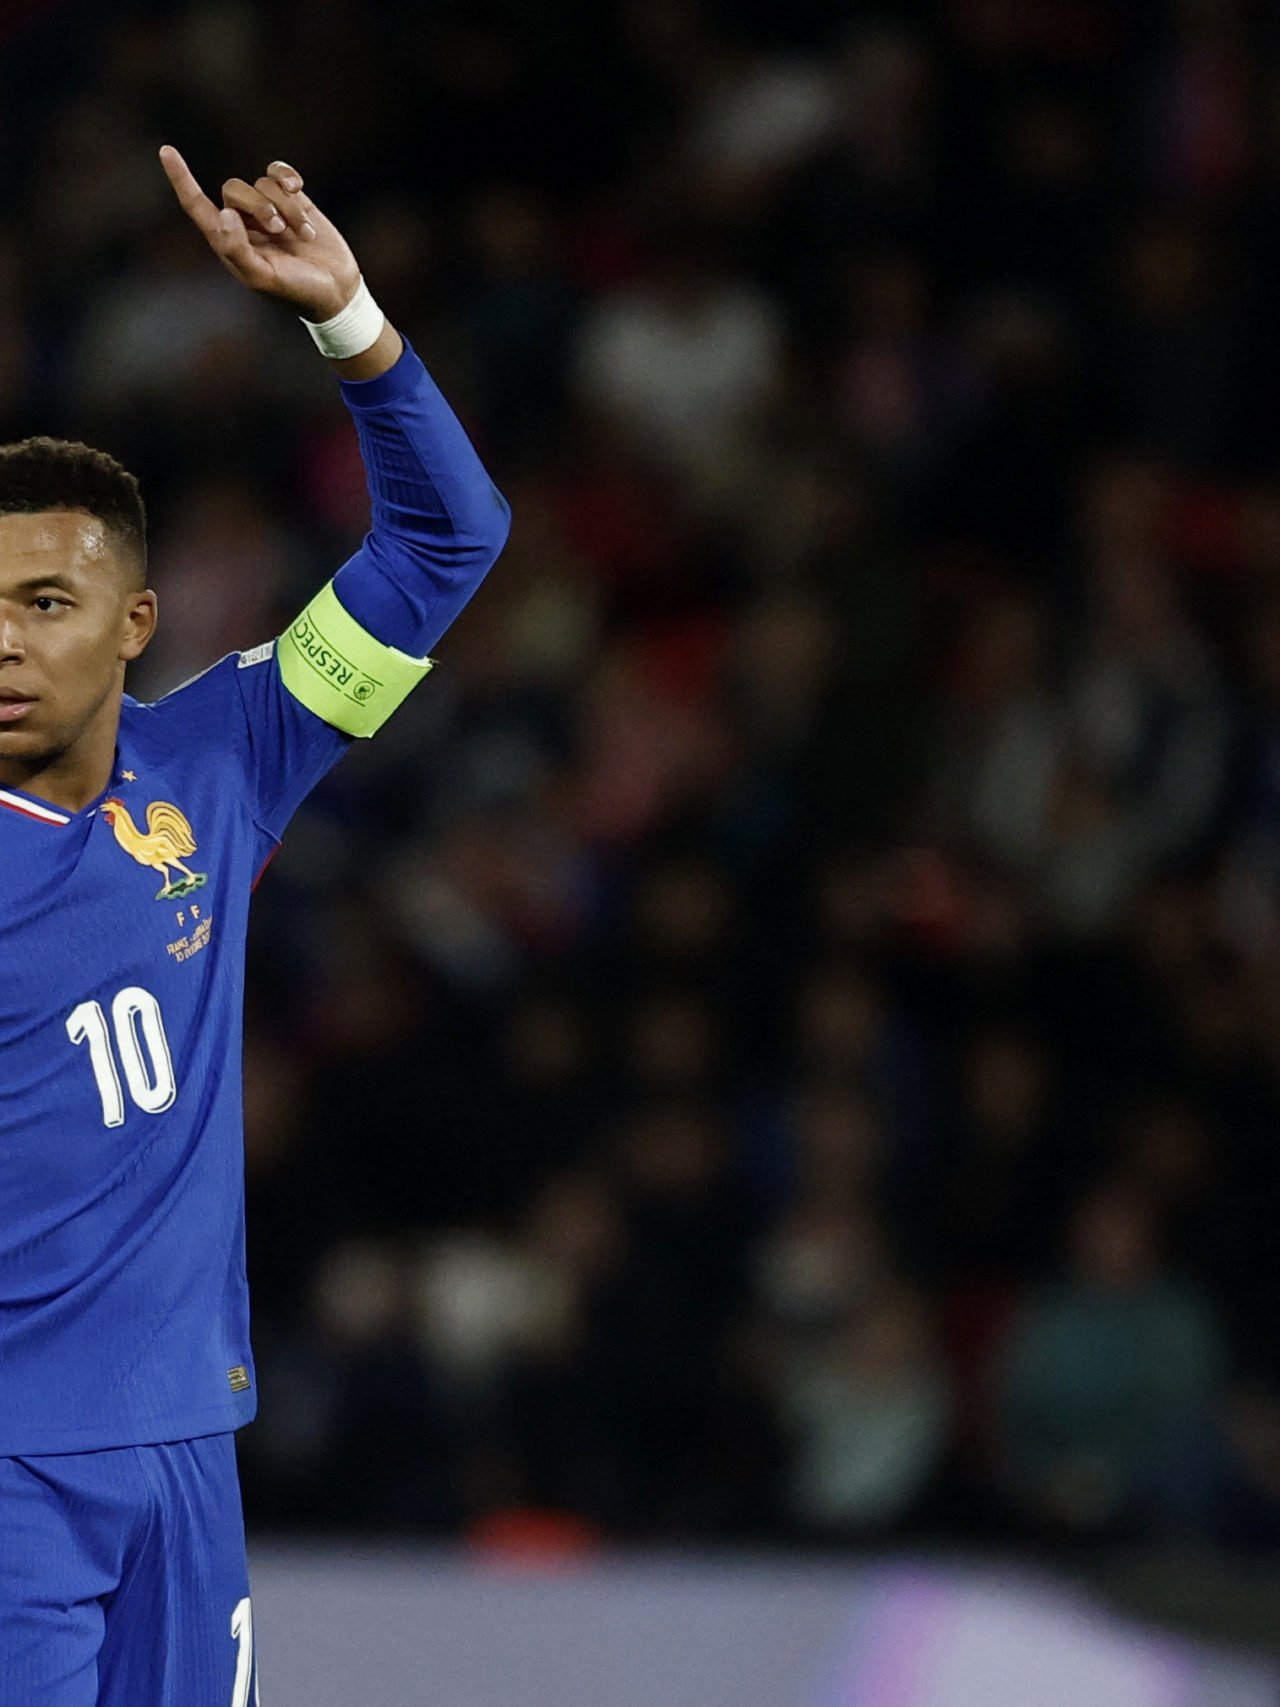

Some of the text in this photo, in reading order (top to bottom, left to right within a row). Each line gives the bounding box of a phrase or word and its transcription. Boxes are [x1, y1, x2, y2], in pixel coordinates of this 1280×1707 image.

[176, 904, 200, 927] F F
[65, 986, 177, 1128] 10
